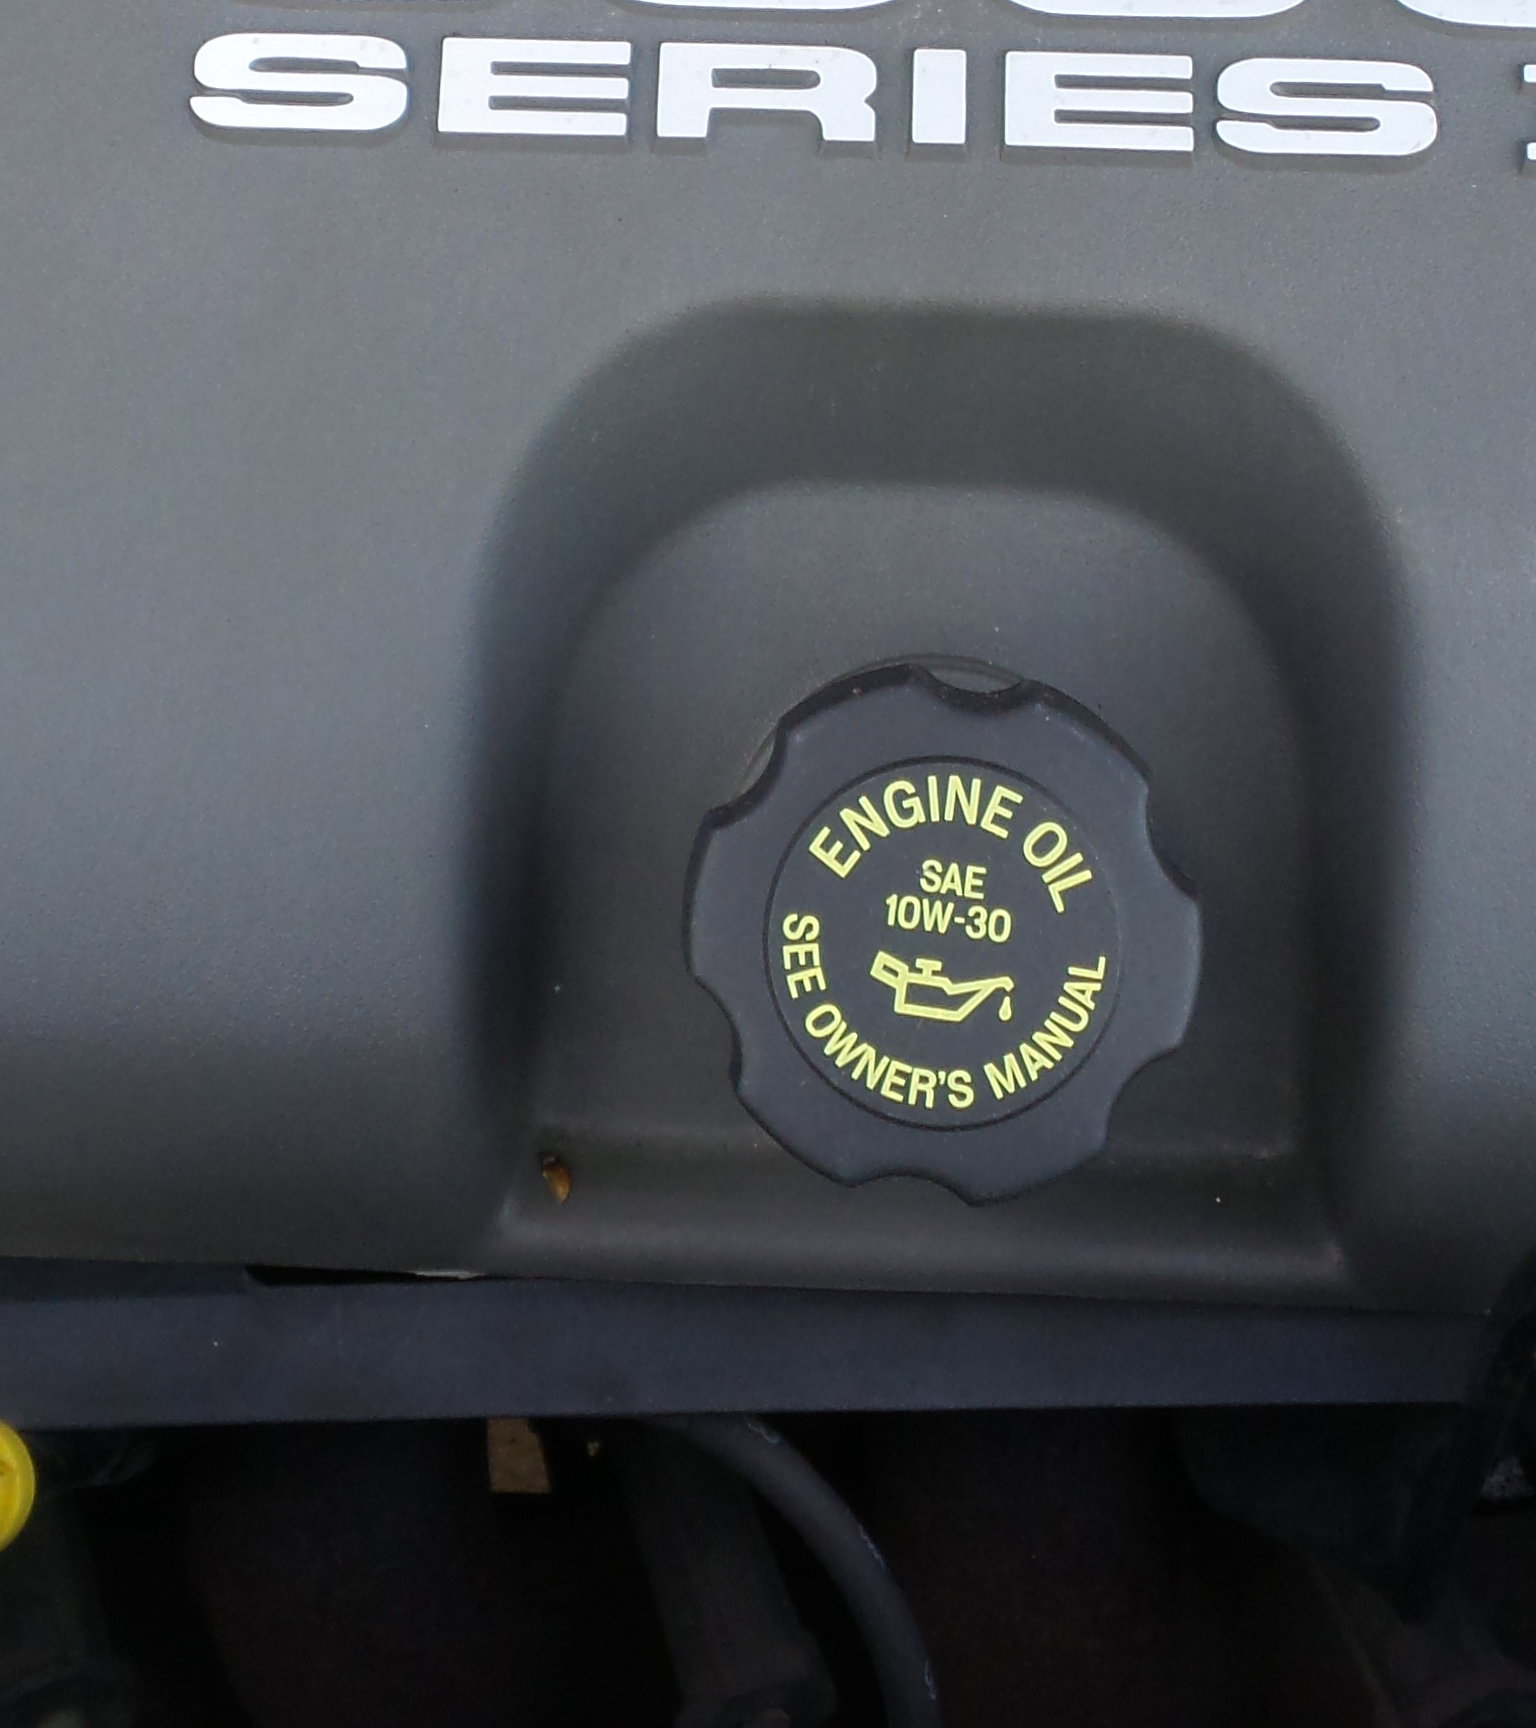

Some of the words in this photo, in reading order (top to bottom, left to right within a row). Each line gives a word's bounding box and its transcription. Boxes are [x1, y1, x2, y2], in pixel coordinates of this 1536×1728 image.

[189, 33, 1438, 159] SERIES
[808, 774, 1025, 879] ENGINE
[1021, 820, 1094, 914] OIL
[919, 859, 987, 901] SAE
[885, 894, 1013, 944] 10W-30
[781, 912, 827, 1000] SEE
[804, 1003, 975, 1110] OWNER'S
[984, 954, 1109, 1102] MANUAL
